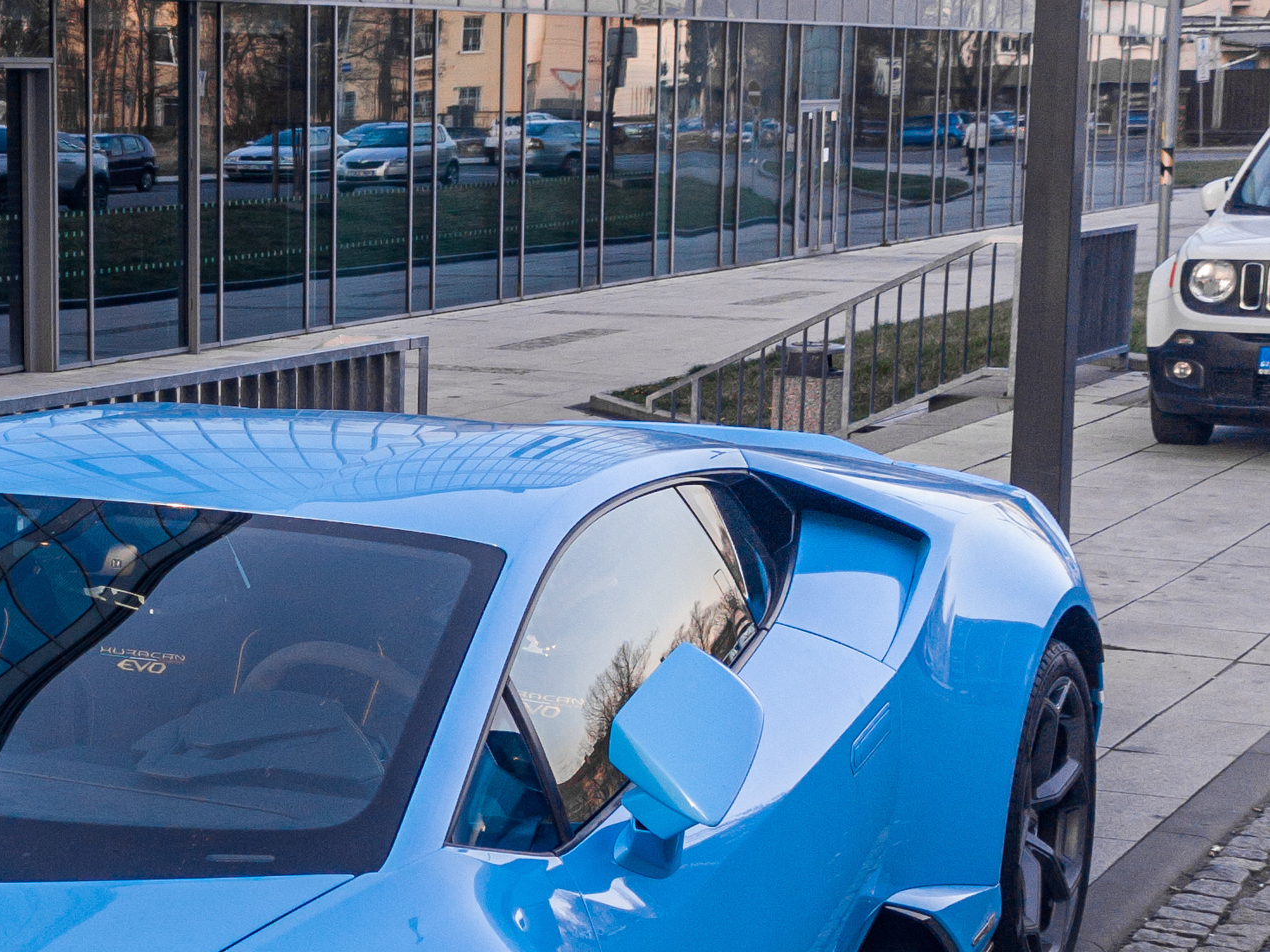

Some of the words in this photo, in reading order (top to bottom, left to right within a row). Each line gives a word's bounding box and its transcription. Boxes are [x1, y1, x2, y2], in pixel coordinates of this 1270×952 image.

[117, 659, 167, 674] EVO
[518, 690, 585, 706] RACAN
[523, 701, 561, 719] VO
